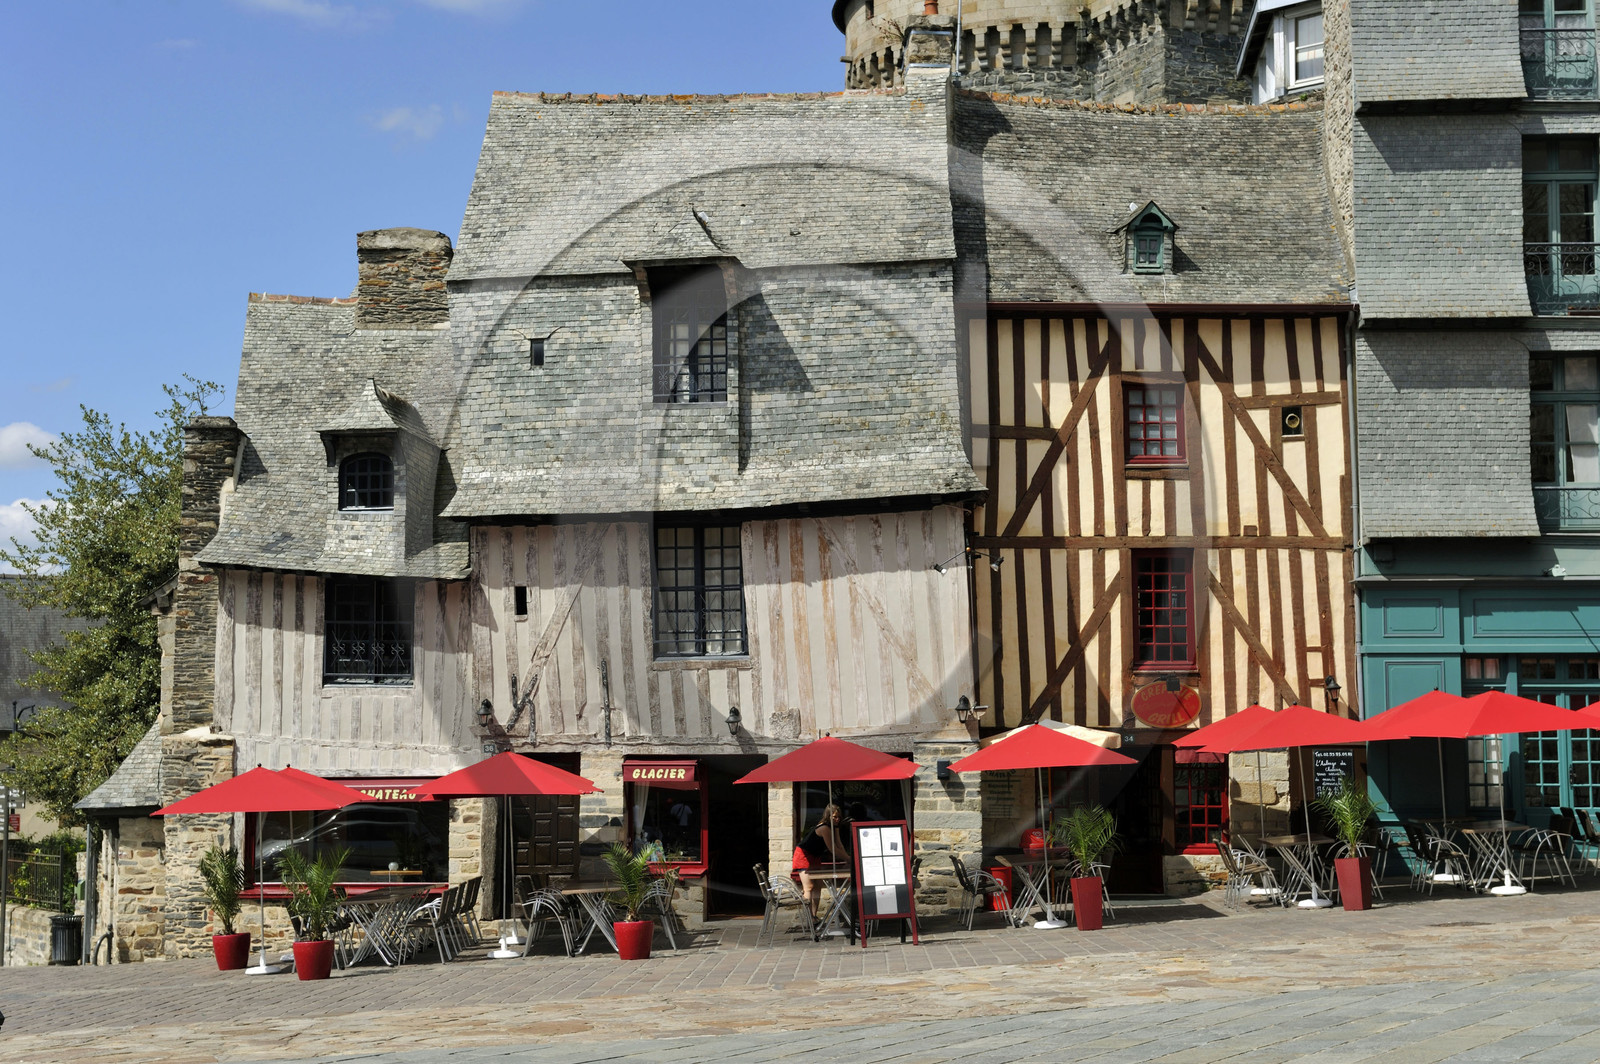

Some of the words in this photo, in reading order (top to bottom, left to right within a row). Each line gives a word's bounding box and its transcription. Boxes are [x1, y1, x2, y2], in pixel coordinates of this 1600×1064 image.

[1141, 685, 1194, 701] CREPIE
[1147, 711, 1185, 724] GRILL
[632, 768, 686, 779] GLACIER
